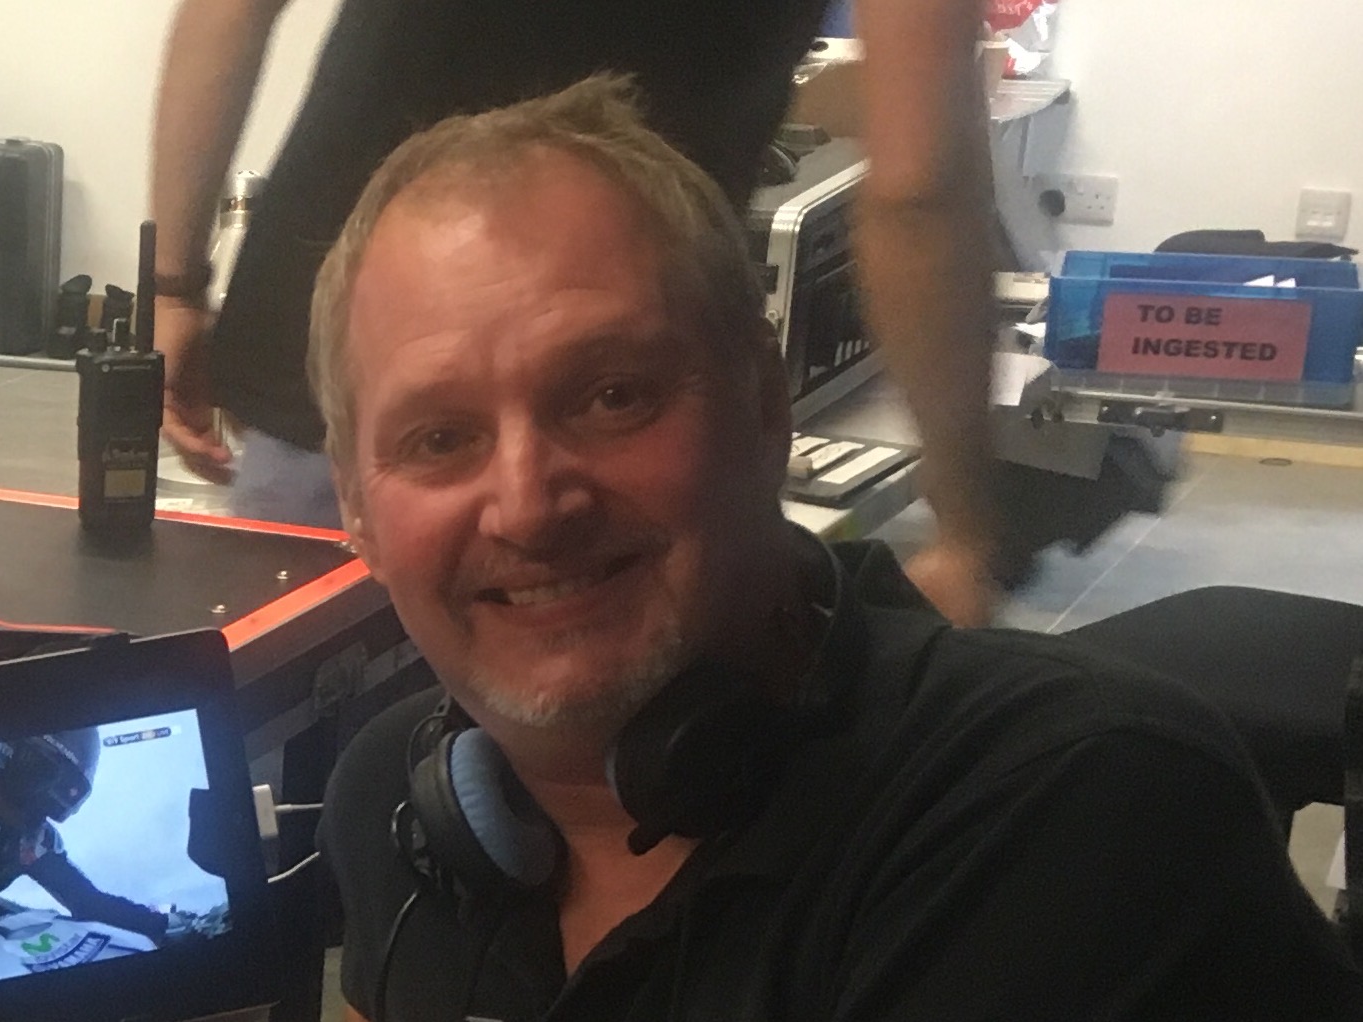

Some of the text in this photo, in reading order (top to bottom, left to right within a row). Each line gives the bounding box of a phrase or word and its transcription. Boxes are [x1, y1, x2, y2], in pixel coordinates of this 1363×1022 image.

[1137, 304, 1222, 327] TO BE
[1131, 337, 1278, 362] INGESTED
